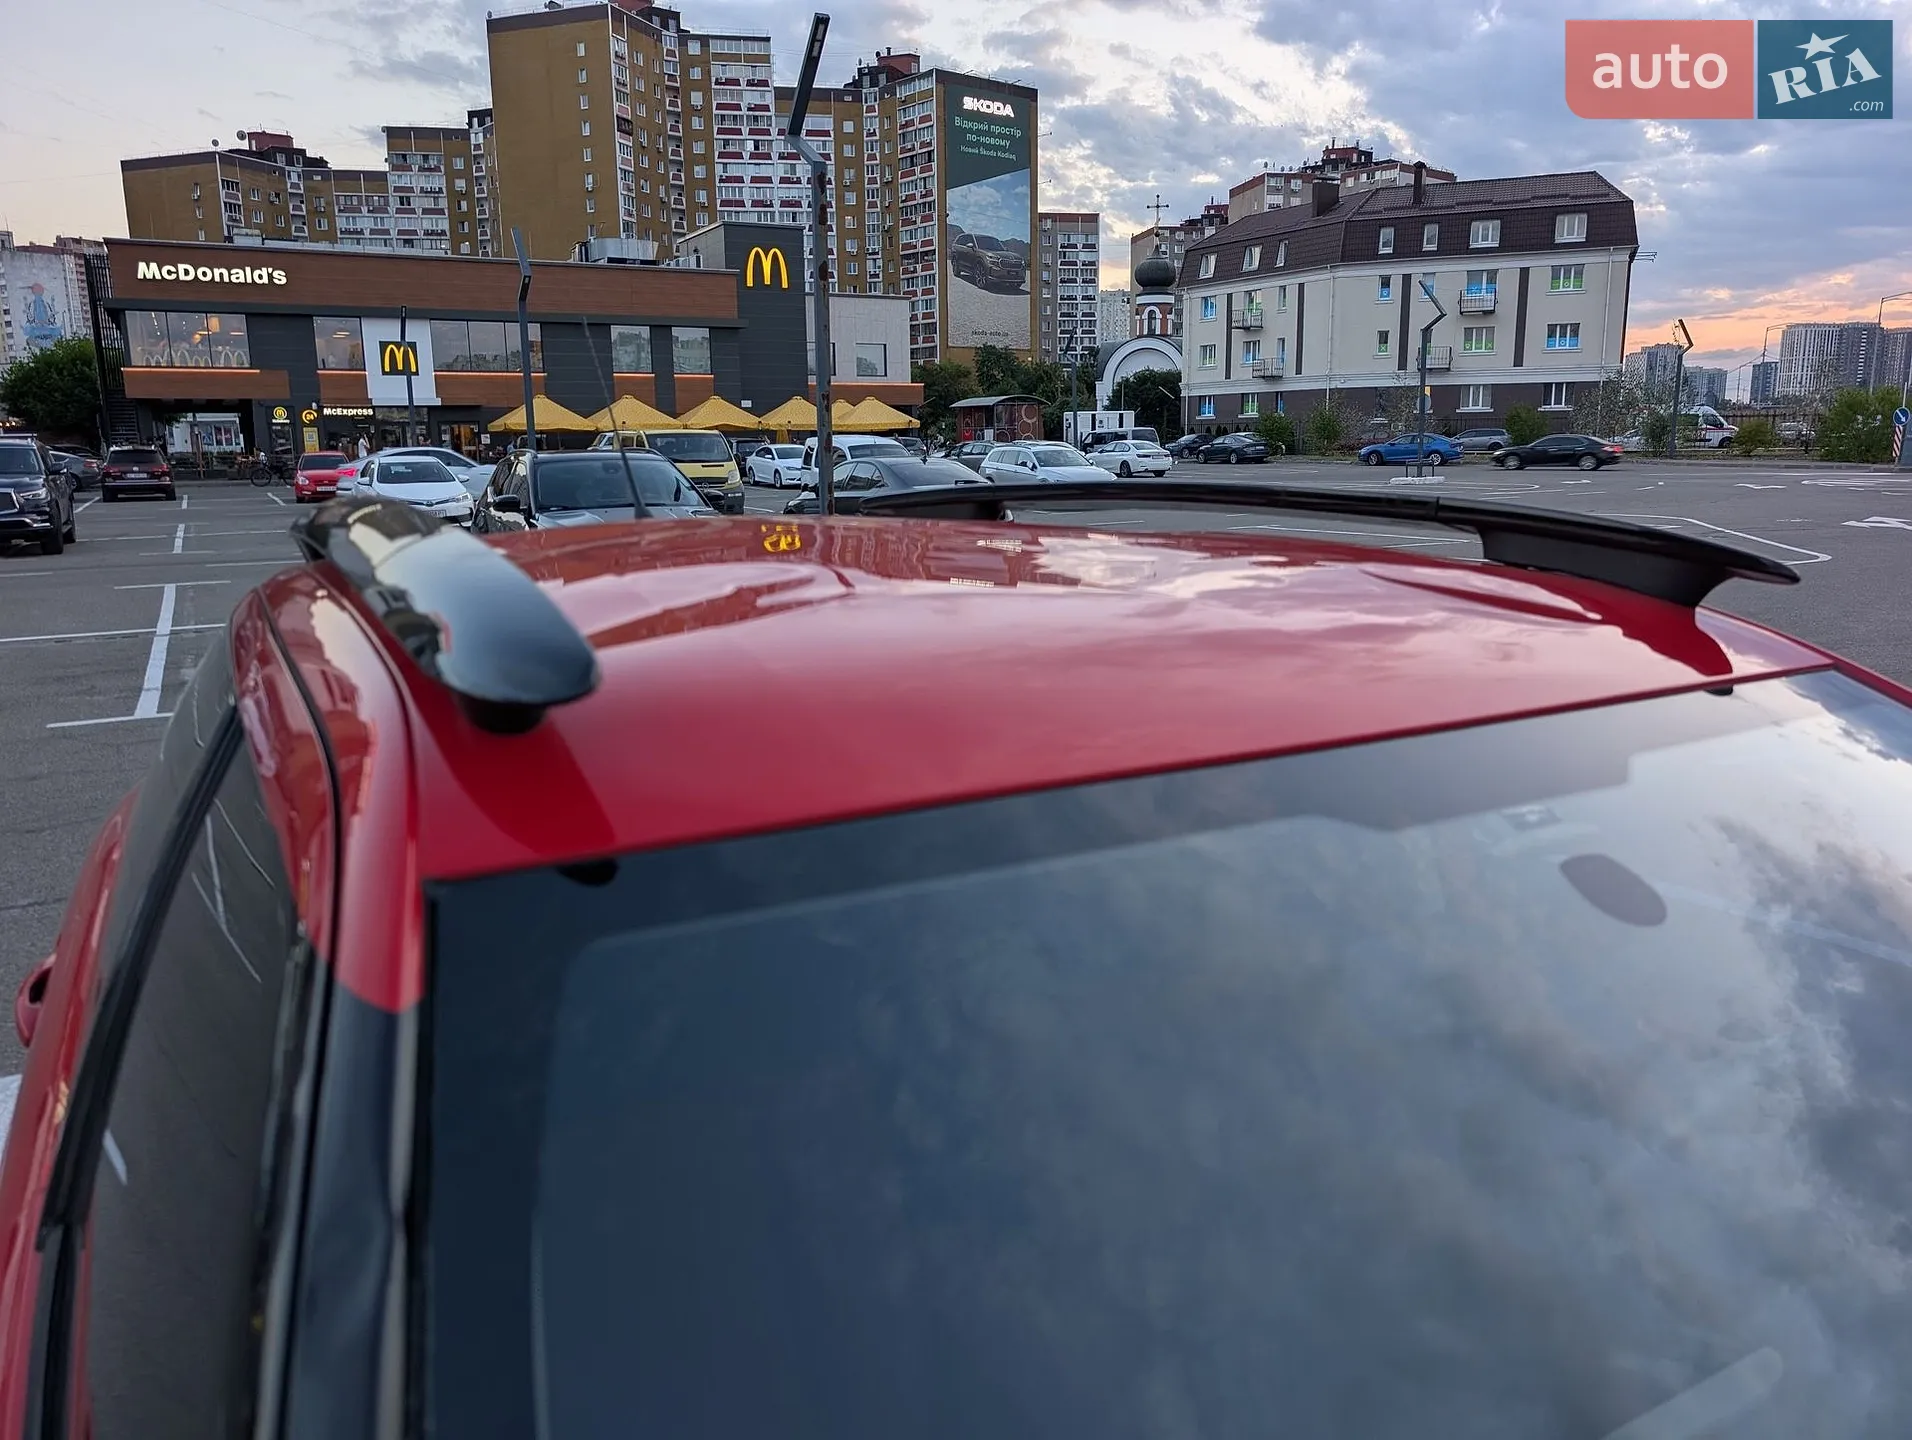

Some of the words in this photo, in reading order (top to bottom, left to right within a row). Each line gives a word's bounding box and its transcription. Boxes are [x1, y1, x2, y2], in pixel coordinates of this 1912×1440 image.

[954, 116, 988, 131] Відкрий
[990, 124, 1022, 138] простір
[966, 133, 1011, 149] по-новому
[137, 261, 288, 286] McDonald's
[323, 408, 374, 416] McExpress
